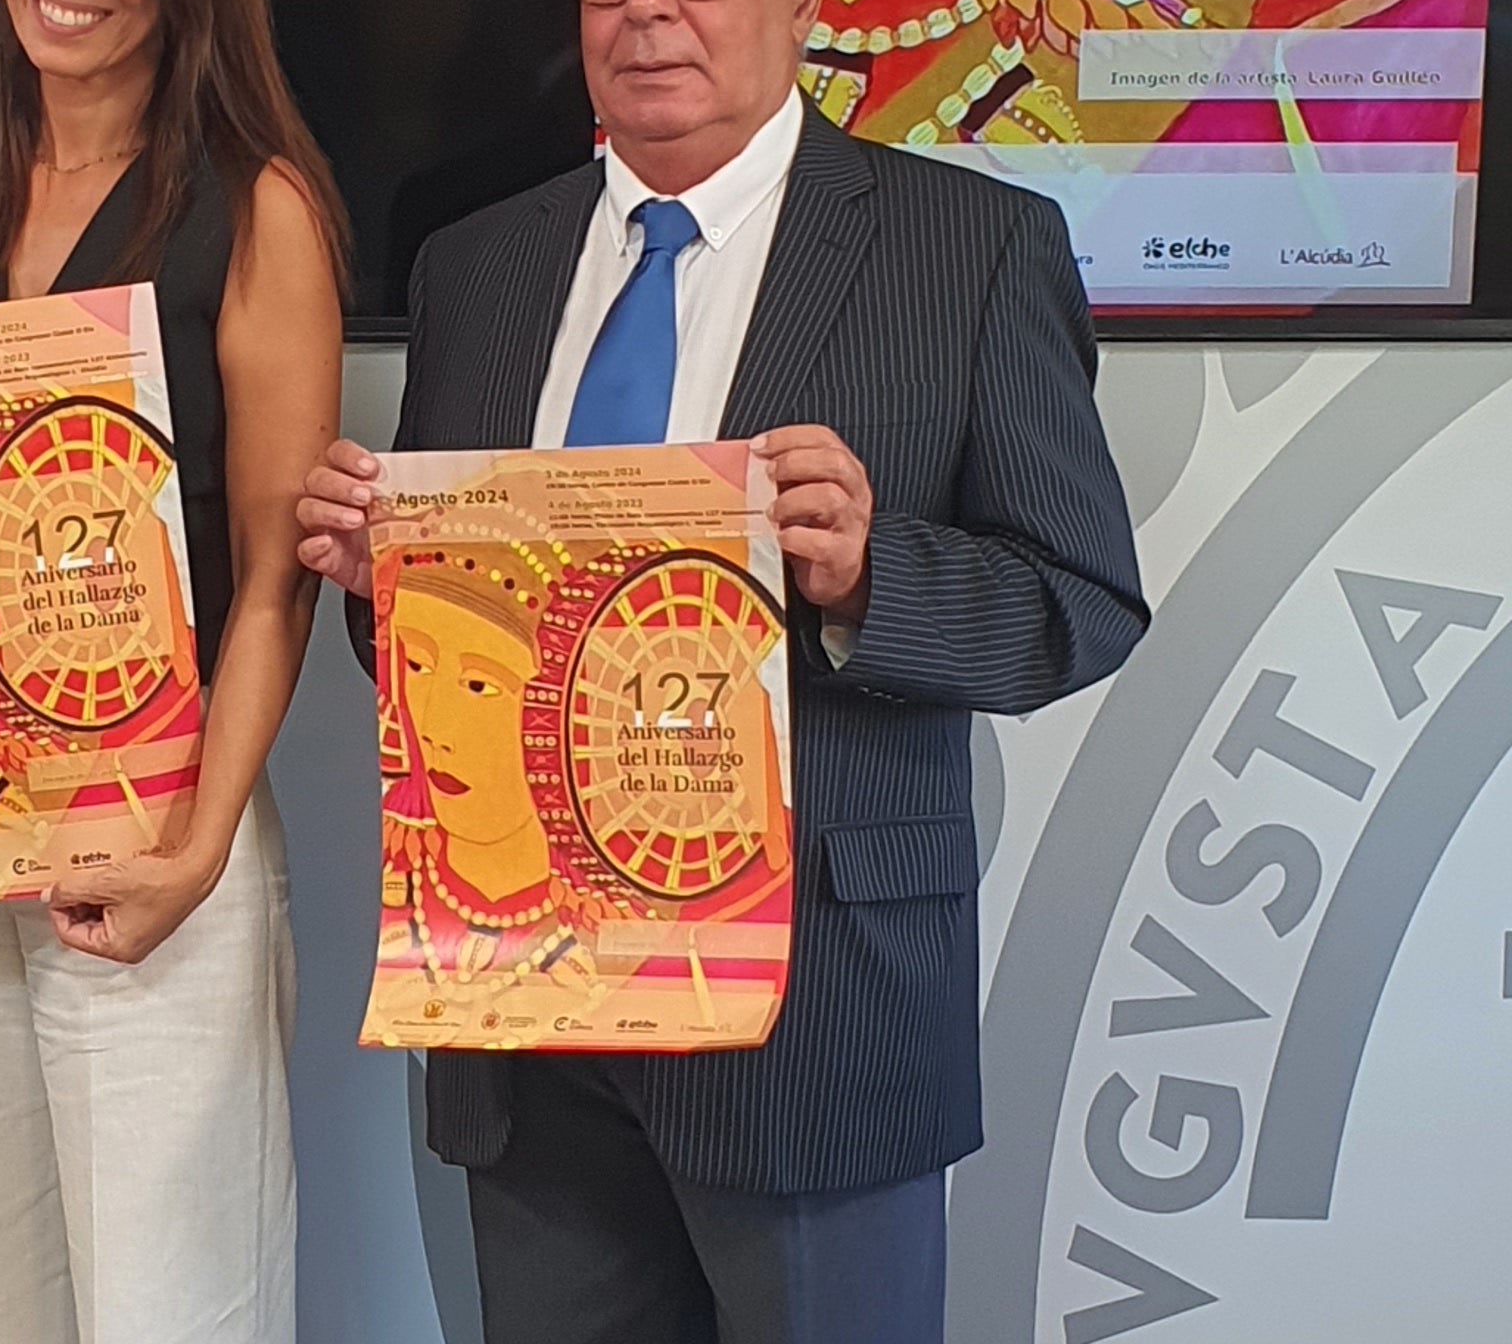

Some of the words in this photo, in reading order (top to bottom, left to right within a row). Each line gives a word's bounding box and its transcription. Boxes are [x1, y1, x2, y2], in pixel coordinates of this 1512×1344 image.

[1110, 71, 1180, 88] Imagen
[1188, 71, 1209, 85] de
[1308, 71, 1364, 85] Laura
[1169, 237, 1230, 260] elche
[396, 492, 457, 509] Agosto
[464, 490, 508, 504] 2024
[22, 510, 126, 573] 127
[22, 556, 136, 587] Aniversario
[23, 590, 53, 611] del
[59, 583, 146, 607] Hallazgo
[28, 617, 51, 635] de
[56, 614, 74, 632] la
[81, 609, 141, 629] Dama
[623, 672, 730, 728] 127
[617, 722, 735, 740] Aniversario
[618, 747, 647, 766] del
[655, 747, 743, 772] Hallazgo
[620, 773, 645, 792] de
[650, 773, 667, 792] la
[674, 775, 734, 793] Dama
